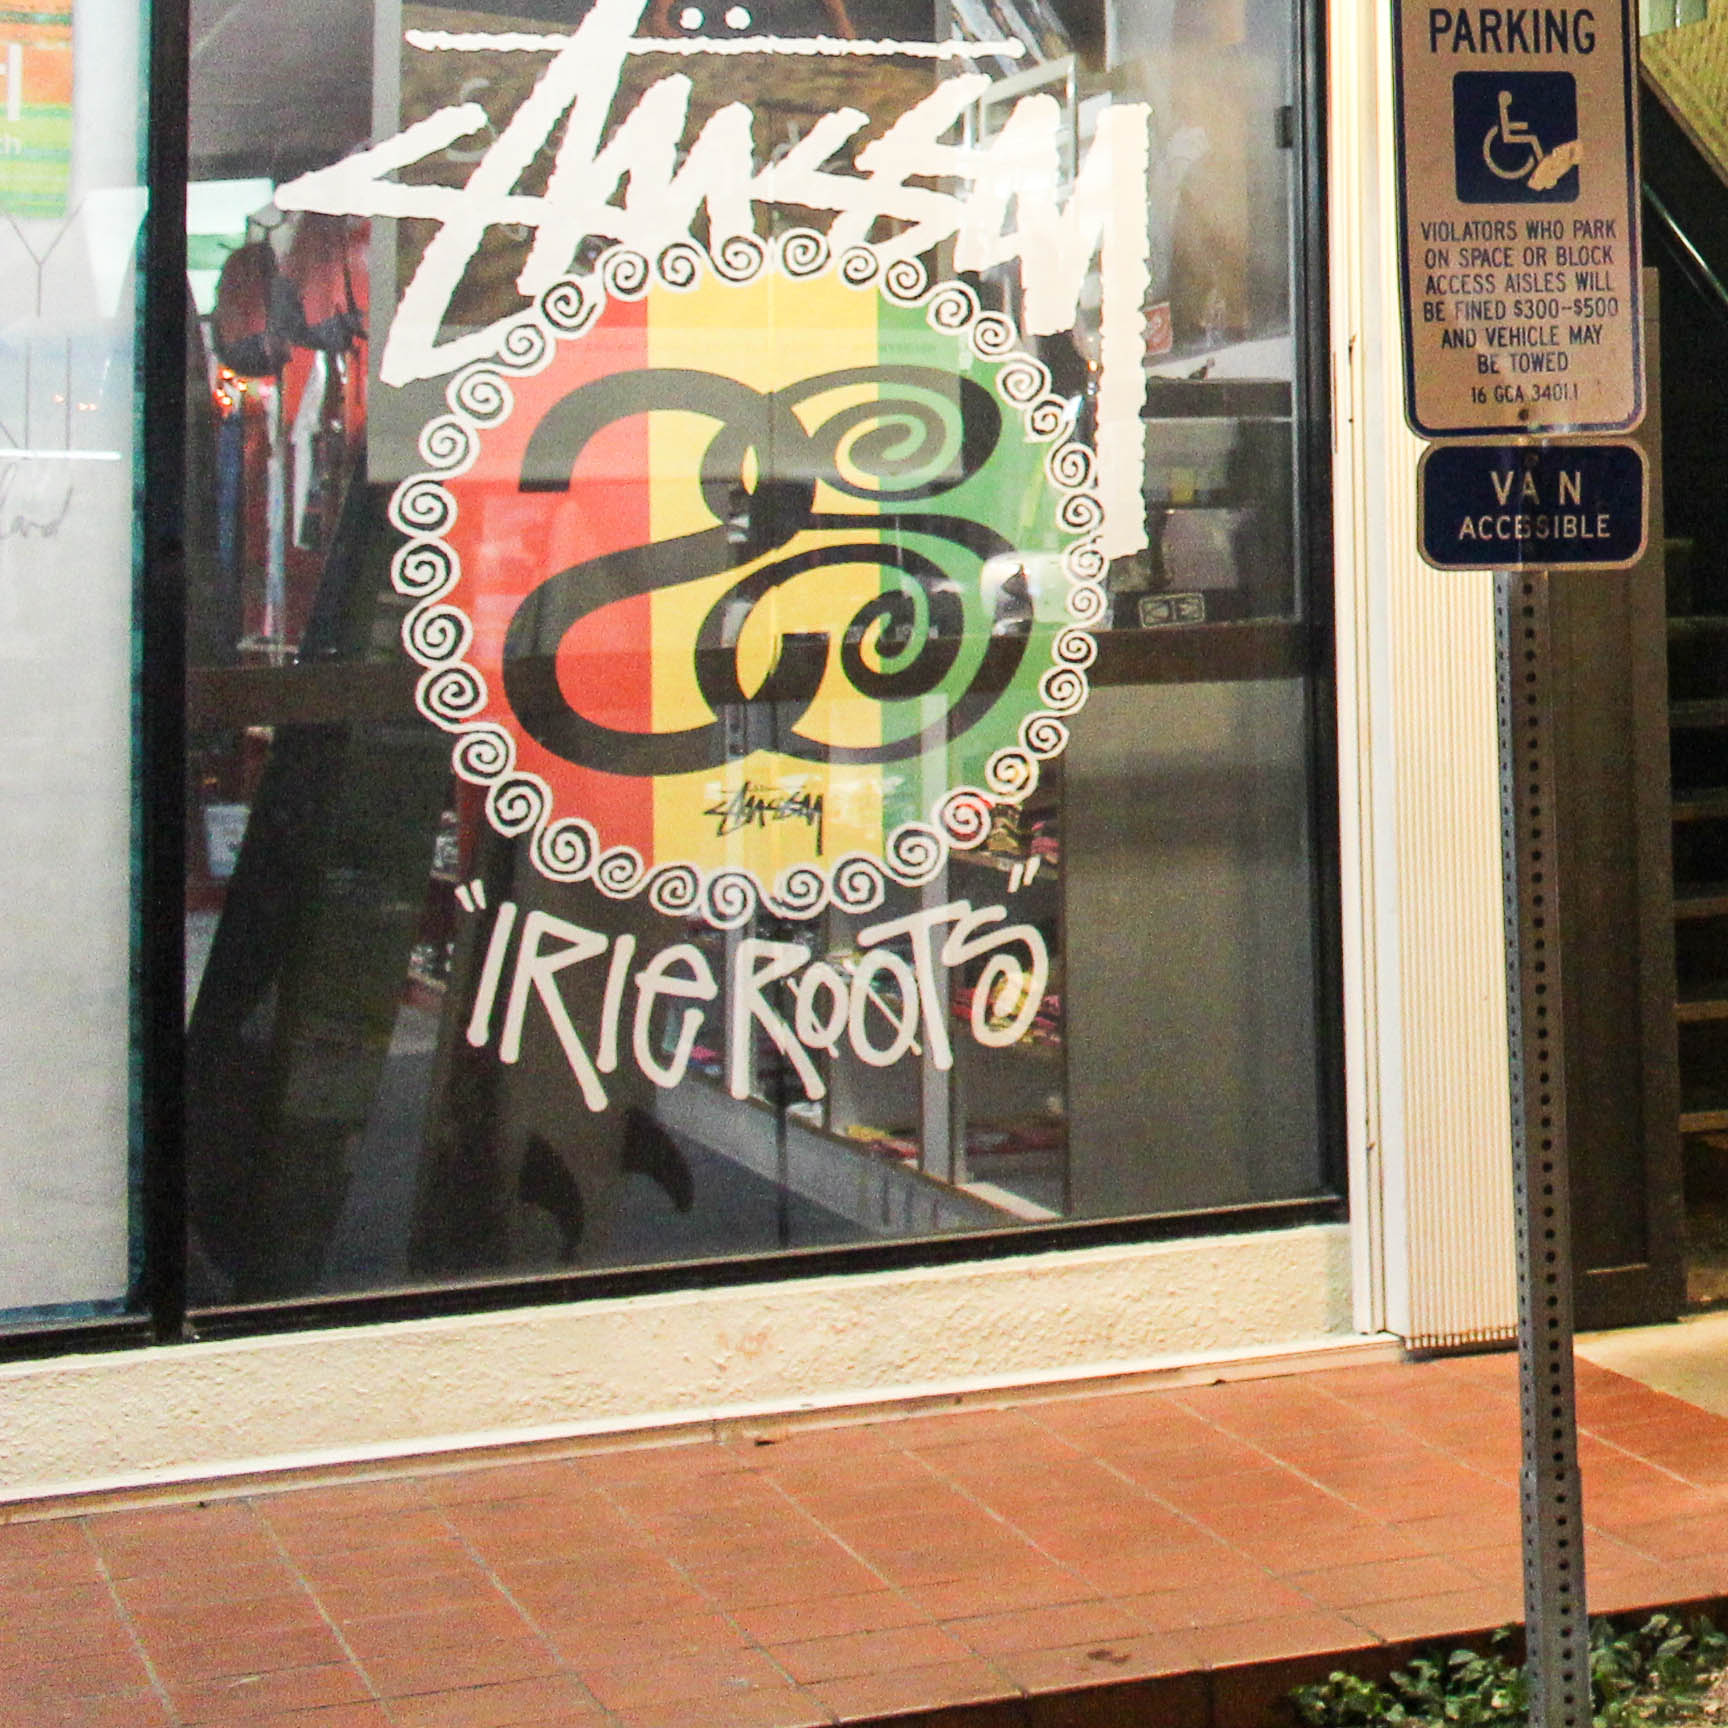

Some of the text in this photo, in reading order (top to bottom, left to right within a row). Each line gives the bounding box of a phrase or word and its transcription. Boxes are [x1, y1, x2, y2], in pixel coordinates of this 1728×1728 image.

[1429, 7, 1596, 55] PARKING
[1420, 219, 1617, 242] VIOLATORS WHO PARK
[1424, 245, 1615, 269] ON SPACE OR BLOCK
[1425, 271, 1615, 295] ACCESS AISLES WILL
[1423, 301, 1446, 322] BE
[1455, 300, 1506, 321] FINED
[1441, 324, 1604, 349] AND VEHICLE MAY
[1476, 351, 1569, 374] BE TOWED
[1471, 385, 1488, 404] 16
[1494, 384, 1525, 404] GCA
[1490, 469, 1582, 508] VAN
[1458, 513, 1612, 542] ACCESSIBLE
